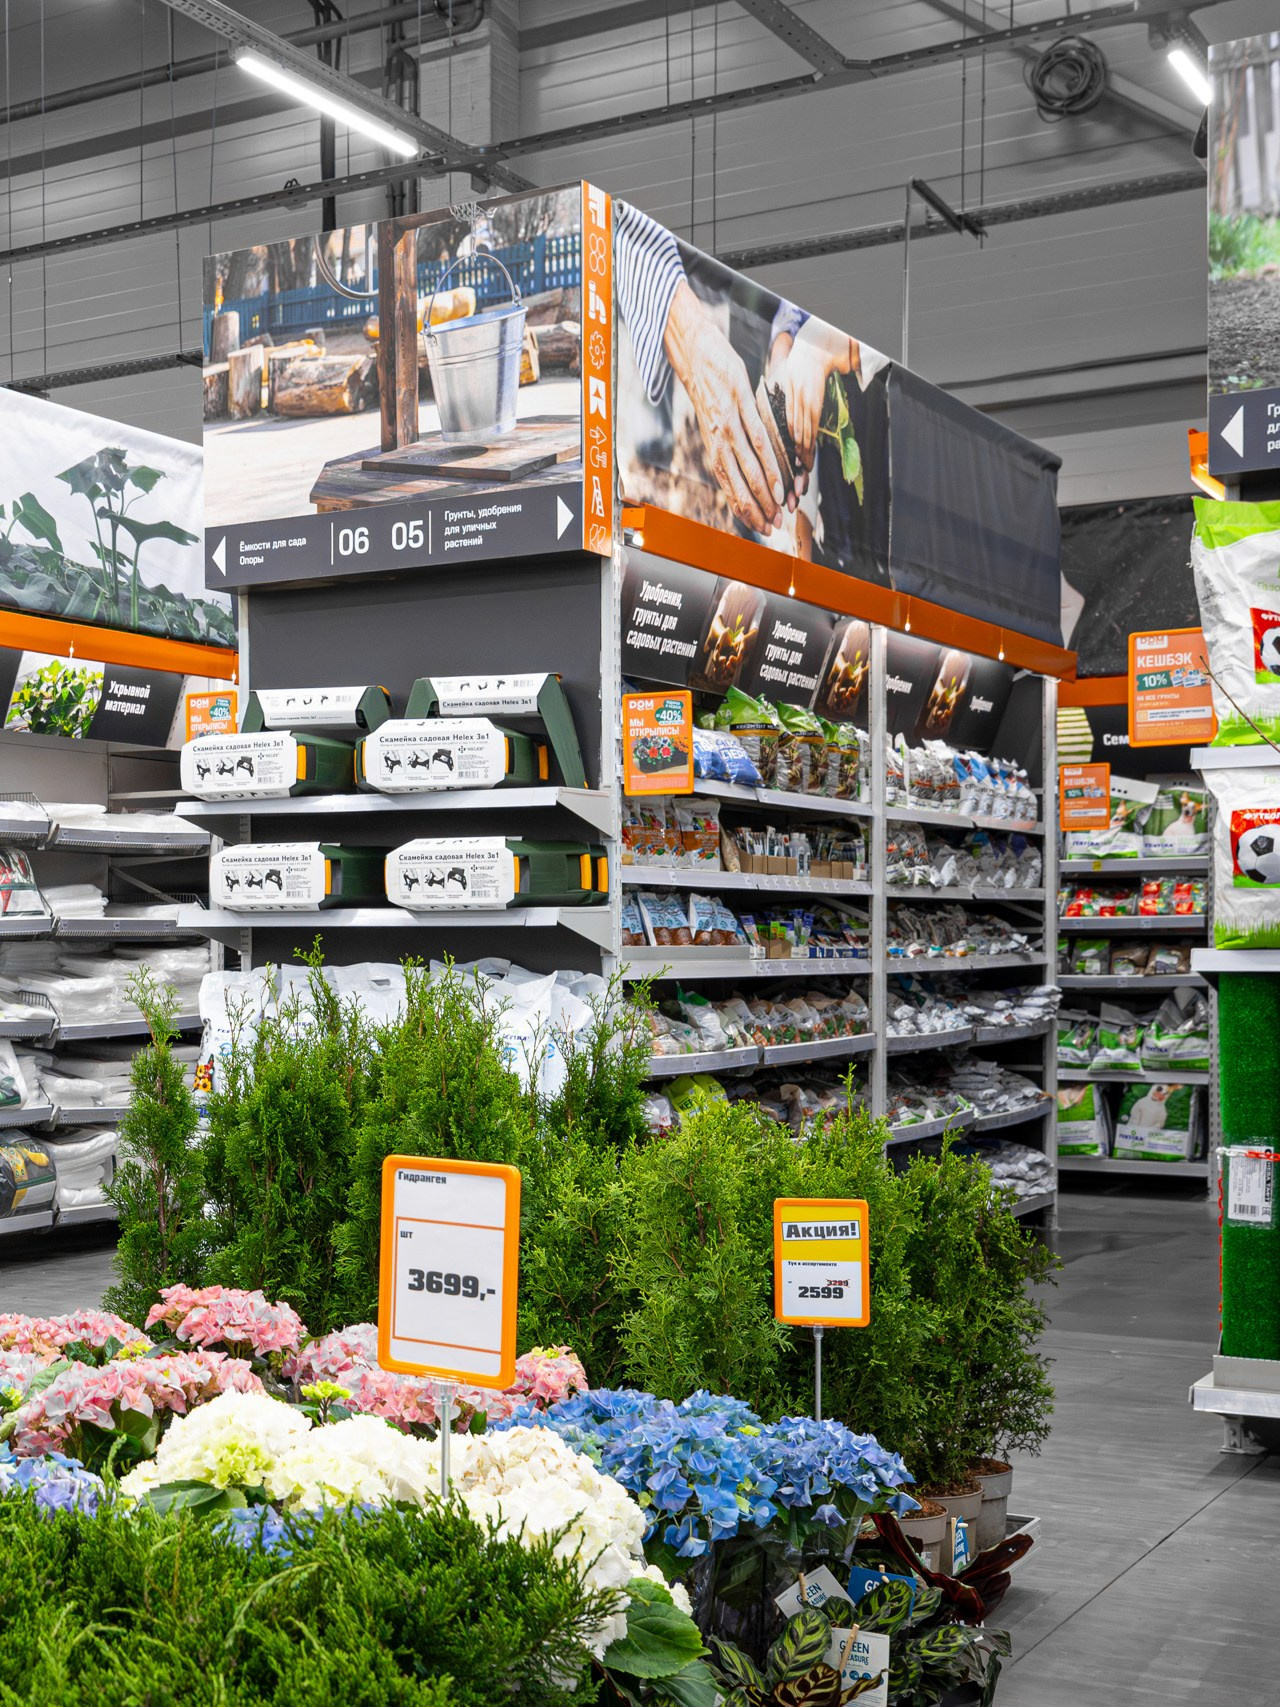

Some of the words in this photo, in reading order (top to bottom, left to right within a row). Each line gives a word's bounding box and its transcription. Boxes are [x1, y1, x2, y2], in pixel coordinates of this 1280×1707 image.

[444, 509, 476, 523] Грунты,
[477, 503, 522, 518] удобрения
[391, 520, 424, 550] 05
[444, 525, 461, 537] для
[463, 521, 497, 535] уличных
[239, 540, 270, 553] Ёмкости
[272, 539, 286, 550] для
[289, 536, 307, 548] сада
[338, 527, 369, 556] 06
[444, 535, 483, 551] растений
[239, 554, 264, 566] Опоры
[639, 579, 682, 610] Удобрения,
[632, 607, 661, 630] грунты
[660, 615, 678, 631] для
[772, 619, 808, 647] Удобрения,
[626, 630, 661, 652] садовых
[660, 639, 698, 659] растений
[764, 643, 789, 663] грунты
[788, 651, 803, 665] для
[1137, 652, 1192, 668] КЕШБЭК
[759, 664, 788, 684] садовых
[787, 671, 818, 691] растений
[1142, 673, 1167, 688] 10%
[108, 680, 150, 699] Укрывной
[104, 698, 146, 716] материал
[629, 699, 654, 711] DOM
[629, 718, 644, 727] МЫ
[660, 710, 681, 721] 40%
[379, 735, 417, 743] Скамейка
[419, 734, 450, 743] садовая
[452, 733, 474, 741] Helex
[476, 732, 490, 740] 3в1
[1103, 733, 1129, 746] Сем
[192, 744, 224, 753] Скамейка
[225, 743, 252, 751] садовая
[253, 741, 271, 749] Helex
[221, 856, 253, 864] Скамейка
[398, 853, 433, 861] Скамейка
[465, 852, 485, 860] Helex
[398, 1170, 447, 1185] Гидрангея
[400, 1230, 414, 1239] шт
[786, 1222, 857, 1239] Акция!
[408, 1268, 496, 1301] 3699,-
[798, 1286, 844, 1299] 2599
[796, 1582, 822, 1603] GEEN
[839, 1640, 870, 1655] GEEN
[841, 1653, 870, 1666] EASURE
